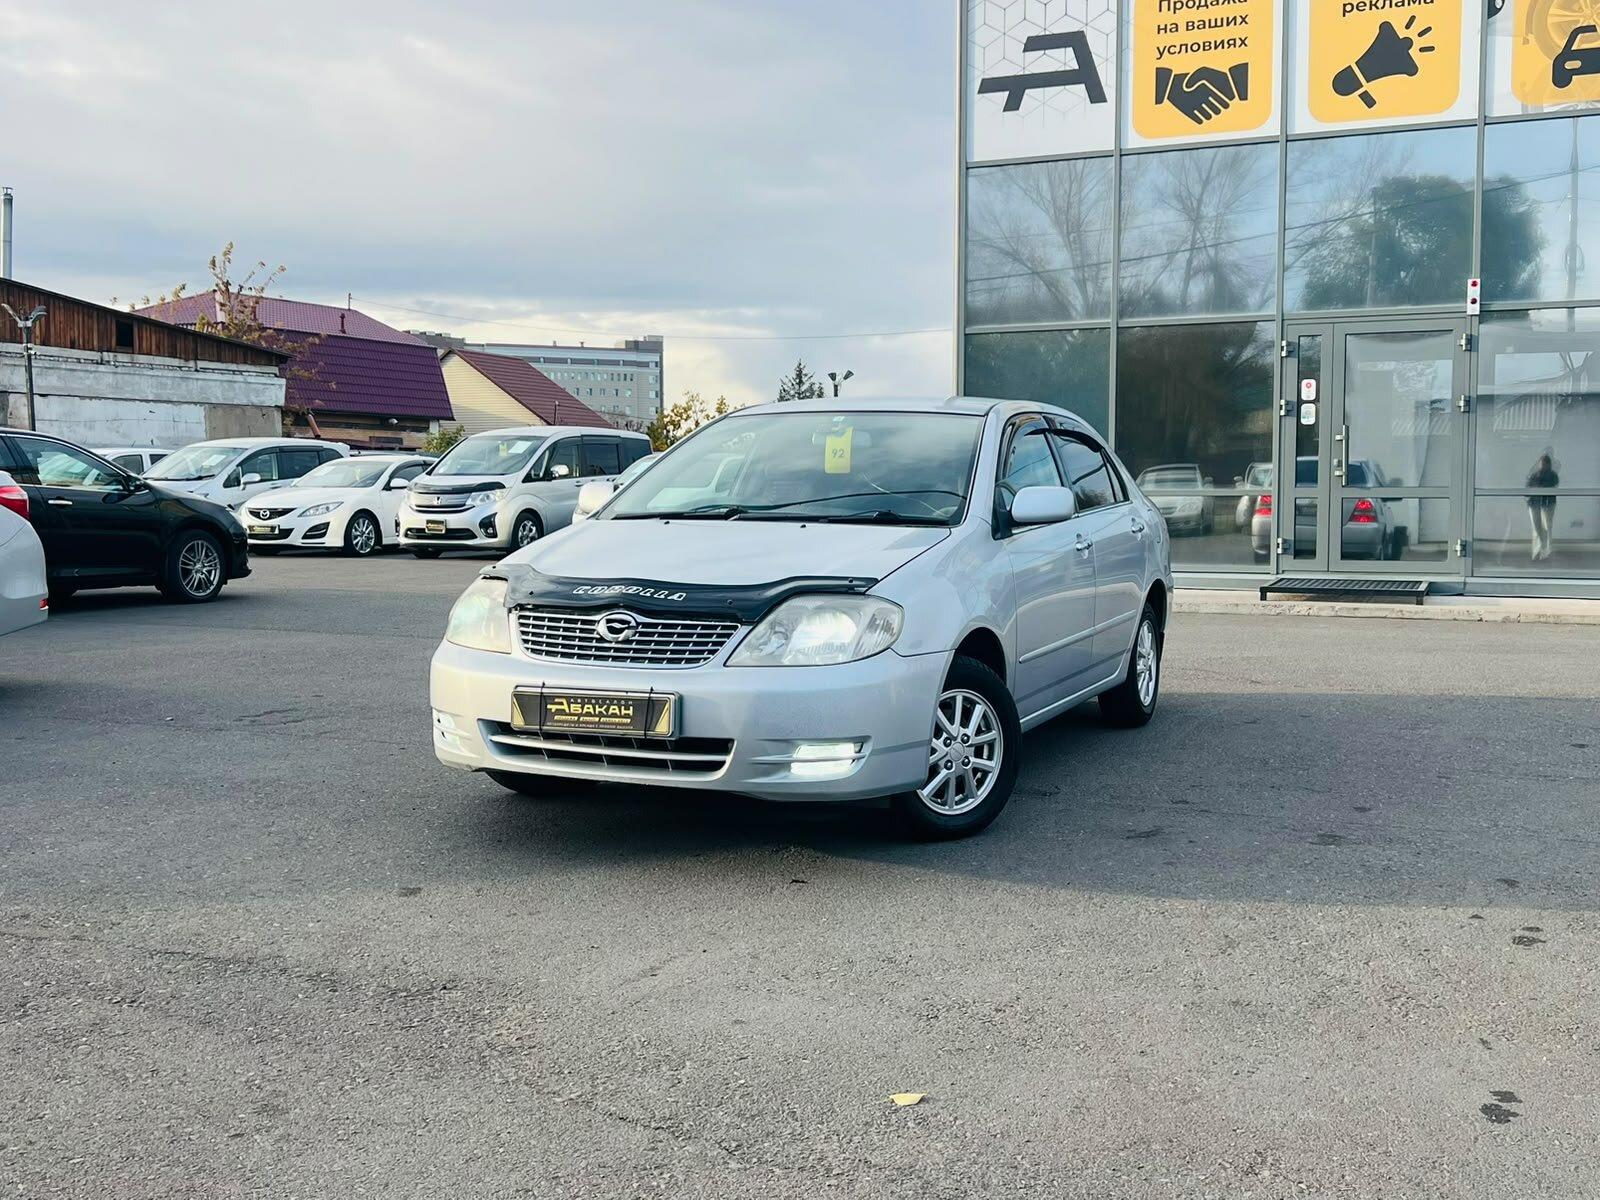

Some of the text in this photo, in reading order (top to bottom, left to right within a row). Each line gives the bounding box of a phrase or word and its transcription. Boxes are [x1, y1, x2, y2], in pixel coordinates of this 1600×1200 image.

[1158, 0, 1248, 14] Прода
[1157, 14, 1249, 34] на ваших
[1156, 37, 1248, 60] условиях
[832, 448, 845, 459] 92
[572, 585, 687, 601] COROLLA
[547, 698, 634, 716] АБАКАН
